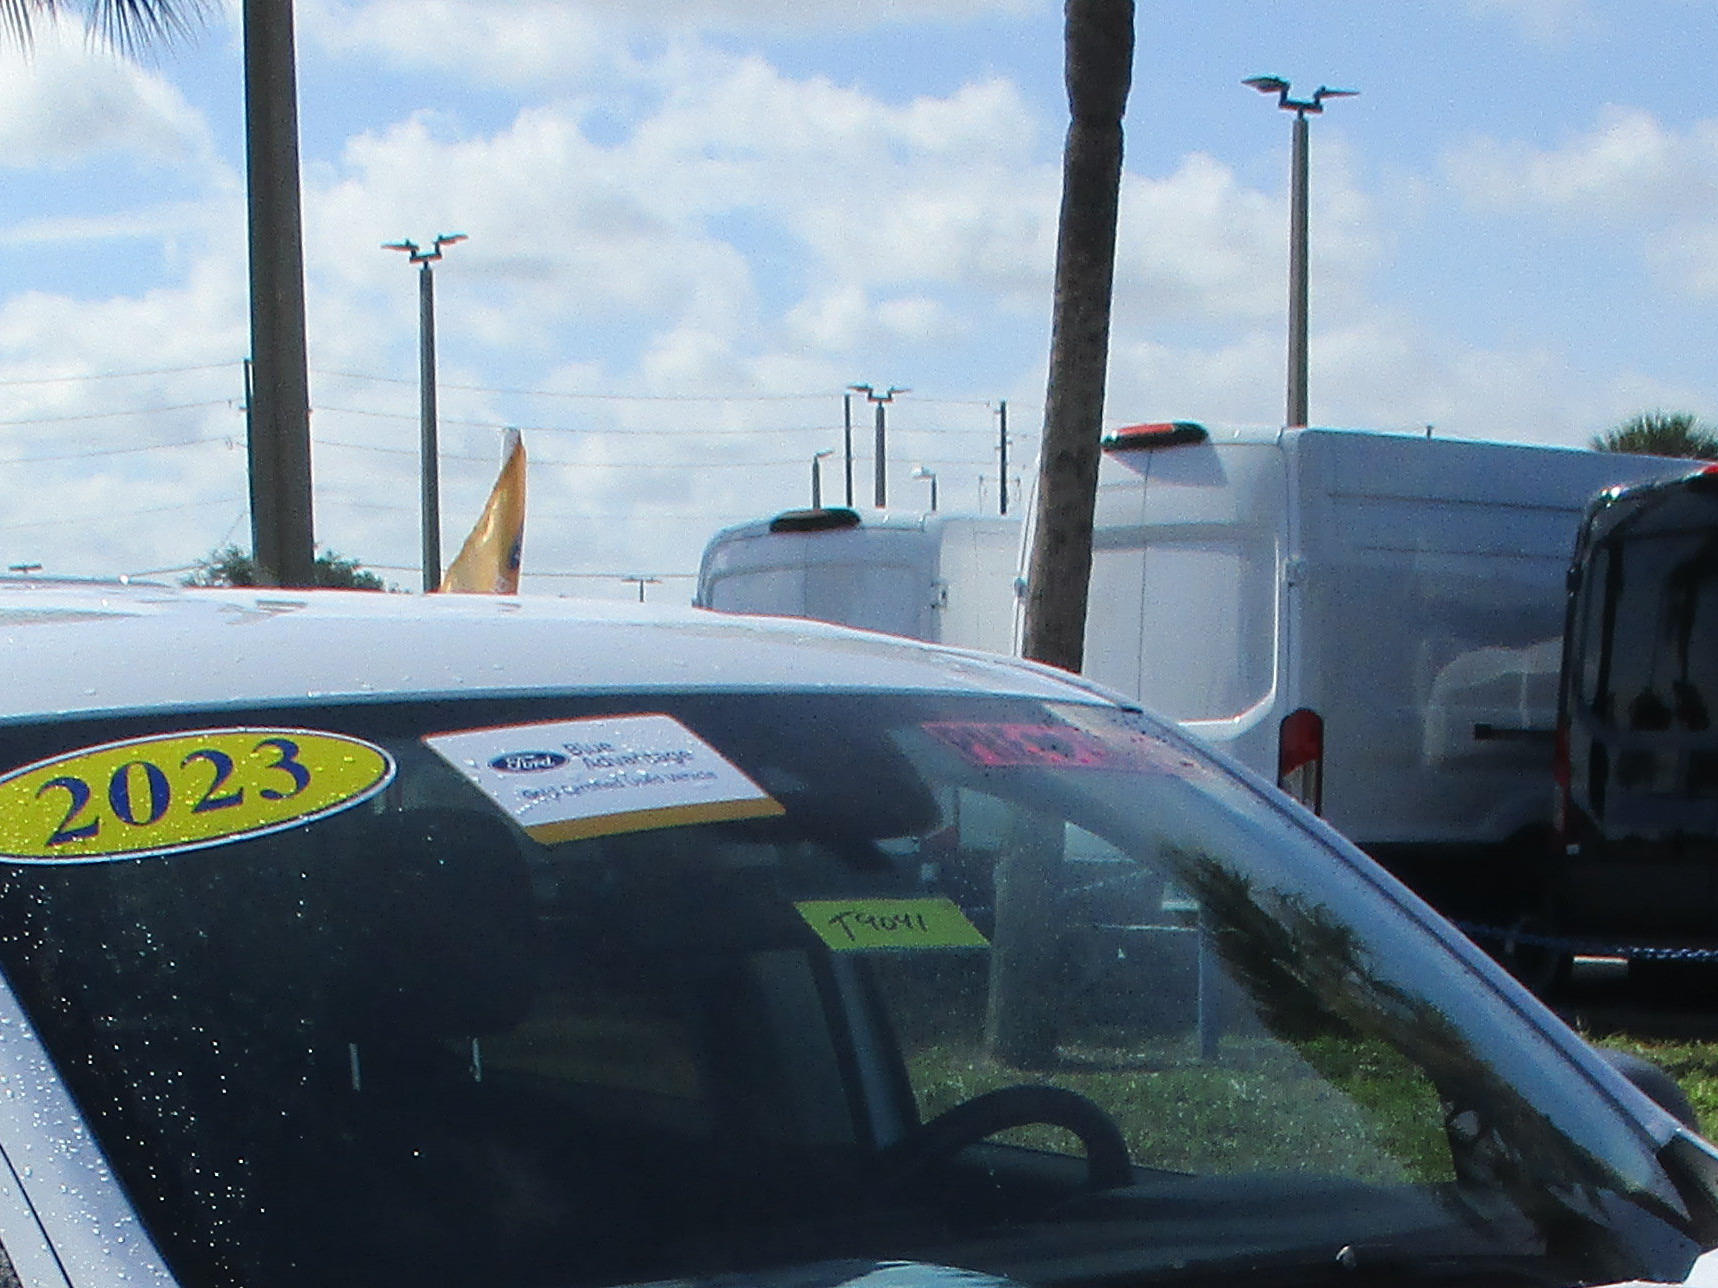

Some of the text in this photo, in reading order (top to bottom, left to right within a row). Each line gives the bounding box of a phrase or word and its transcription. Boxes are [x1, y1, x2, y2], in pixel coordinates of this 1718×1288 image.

[561, 741, 615, 757] Blue
[583, 750, 695, 770] Advantage
[34, 737, 311, 847] 2023
